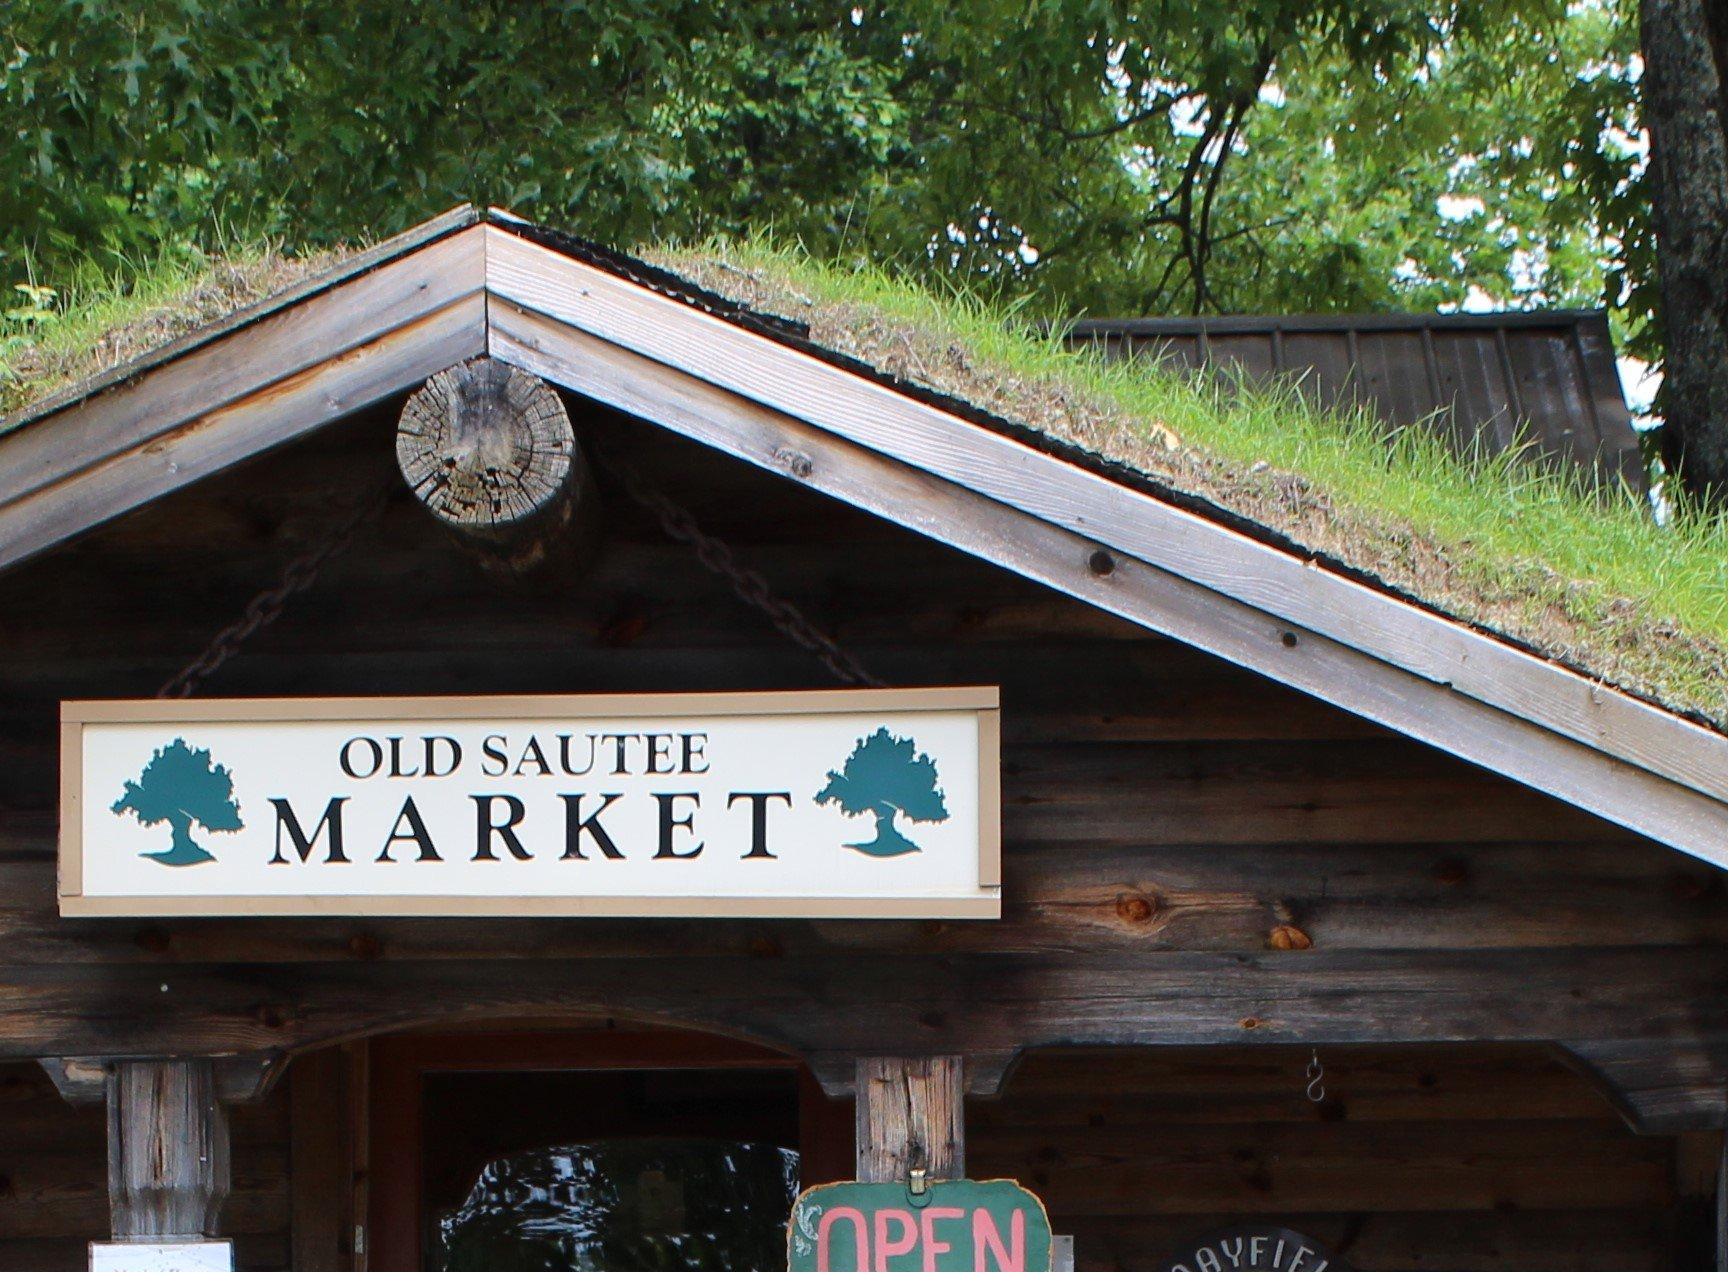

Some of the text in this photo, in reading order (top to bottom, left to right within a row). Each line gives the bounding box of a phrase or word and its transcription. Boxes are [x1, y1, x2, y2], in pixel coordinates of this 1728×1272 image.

[339, 732, 710, 779] OLD SAUTEE
[267, 791, 793, 865] MARKET
